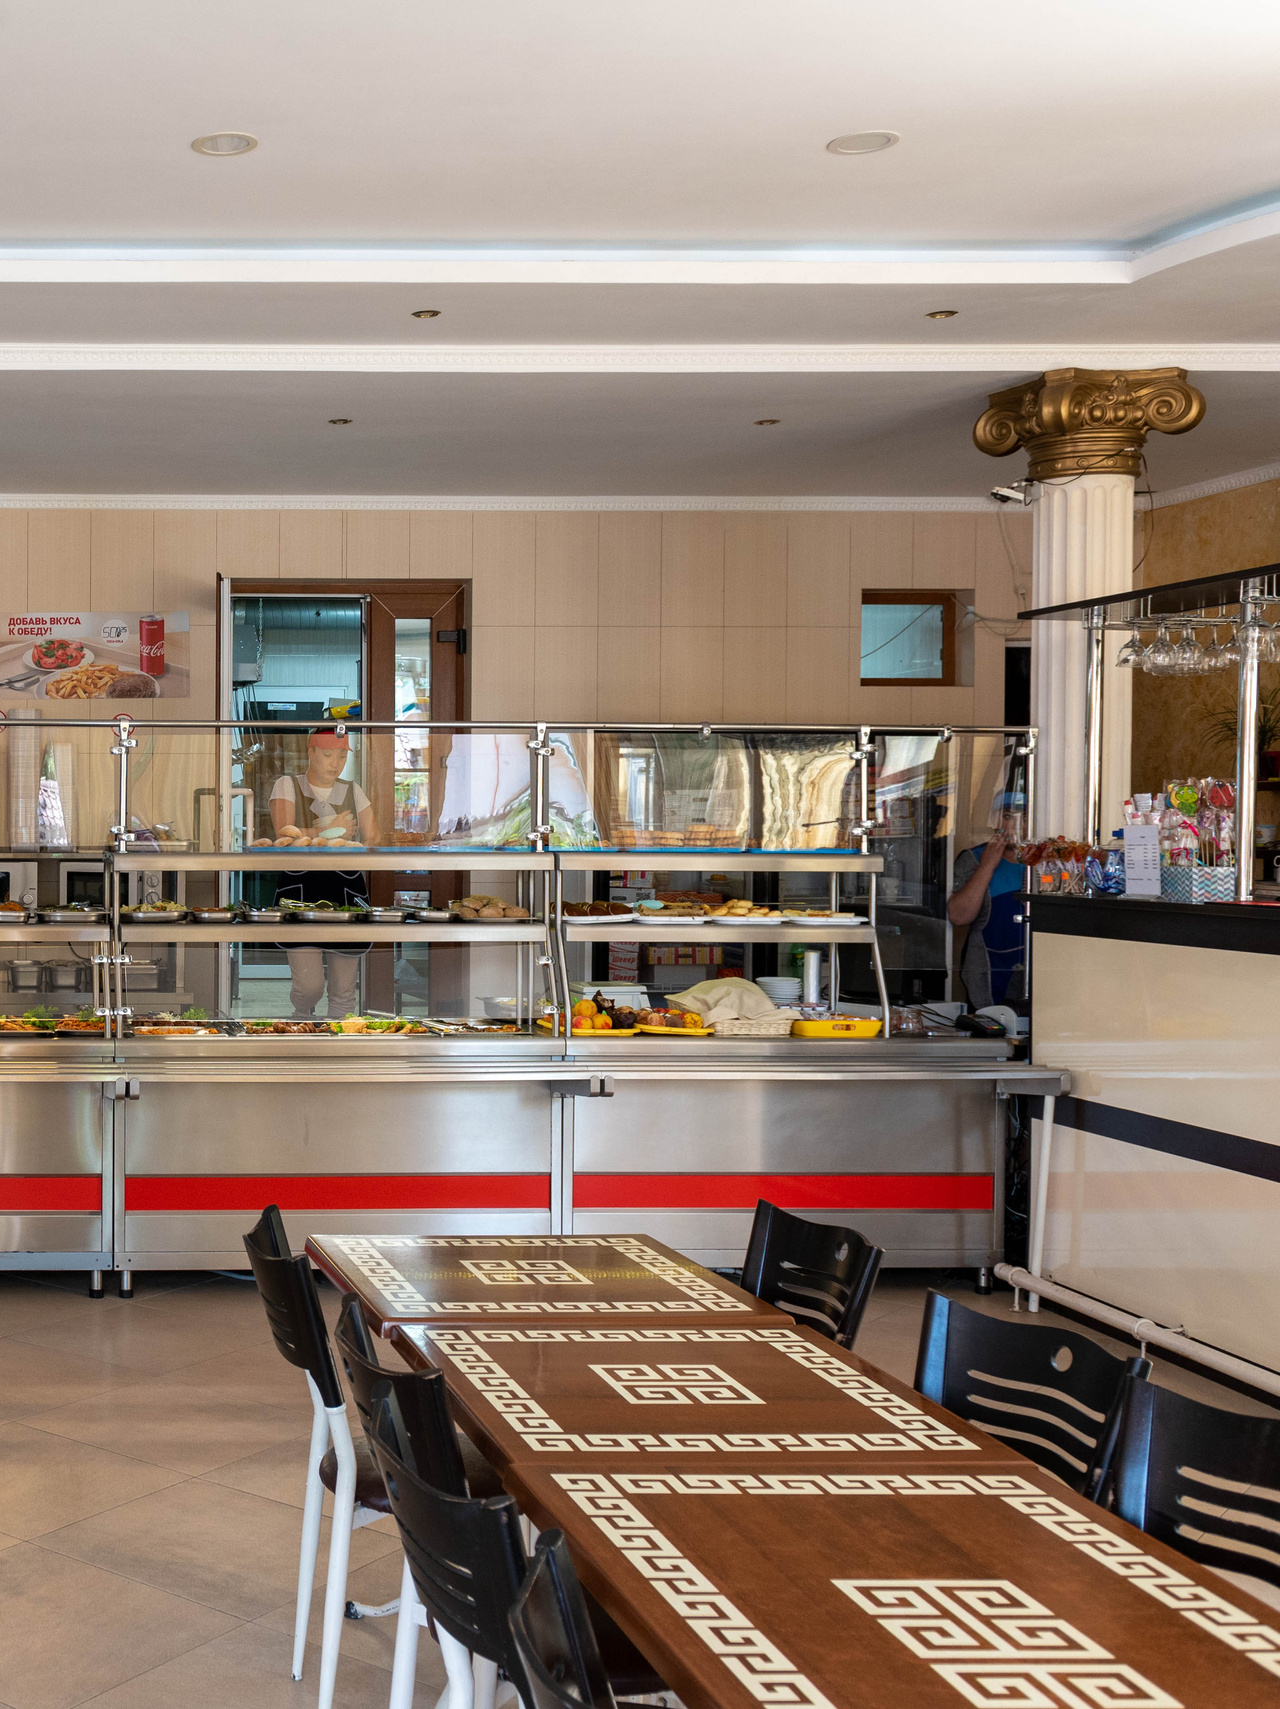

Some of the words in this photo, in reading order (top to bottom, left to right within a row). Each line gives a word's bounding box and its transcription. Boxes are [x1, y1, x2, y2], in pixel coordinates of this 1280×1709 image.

[8, 617, 47, 627] ДОБАВЬ
[49, 617, 81, 625] ВКУСА
[8, 627, 15, 636] К
[17, 627, 52, 636] ОБЕДУ!
[612, 956, 636, 964] Шекер
